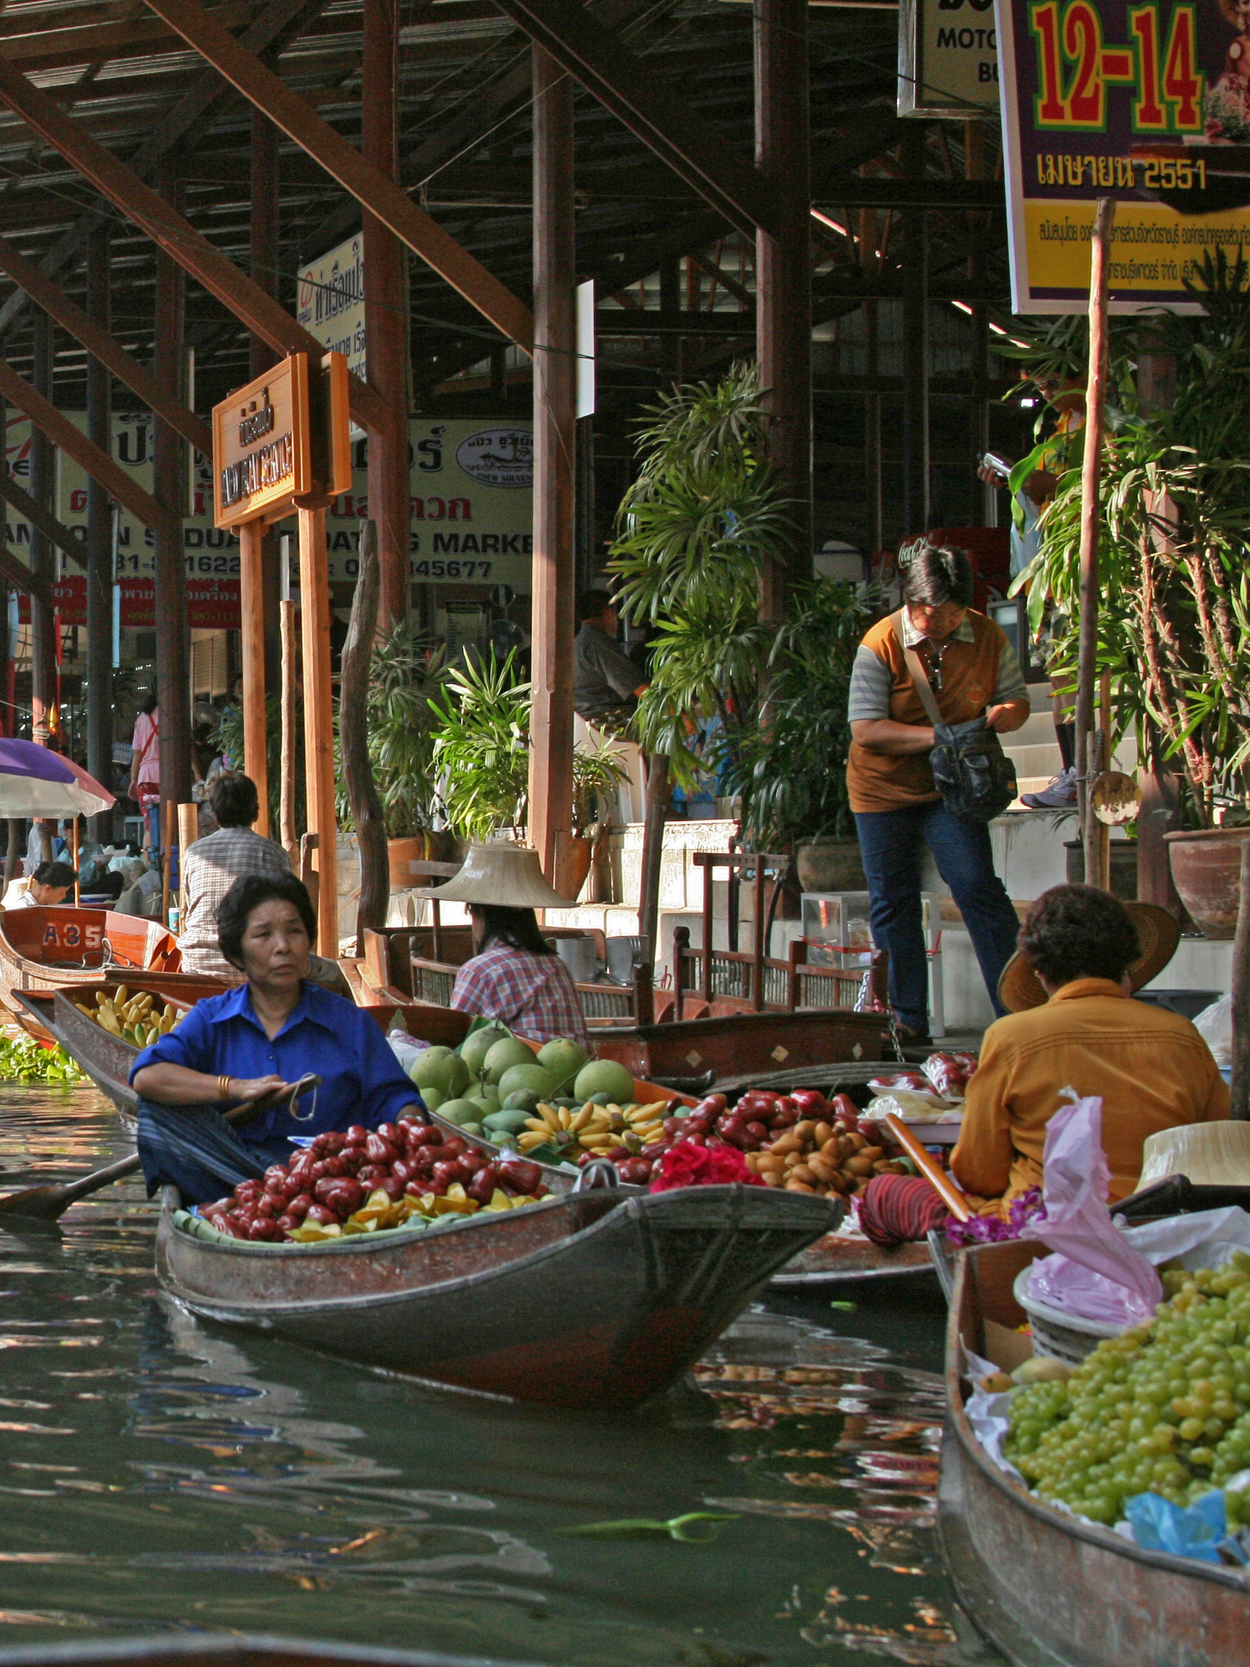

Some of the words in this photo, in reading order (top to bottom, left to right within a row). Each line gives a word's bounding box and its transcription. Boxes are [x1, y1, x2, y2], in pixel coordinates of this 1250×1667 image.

[1029, 0, 1206, 135] 12-14
[1036, 153, 1135, 188] เมษายน
[1143, 158, 1206, 189] 2551
[432, 533, 534, 554] MARKE
[43, 922, 101, 949] A35
